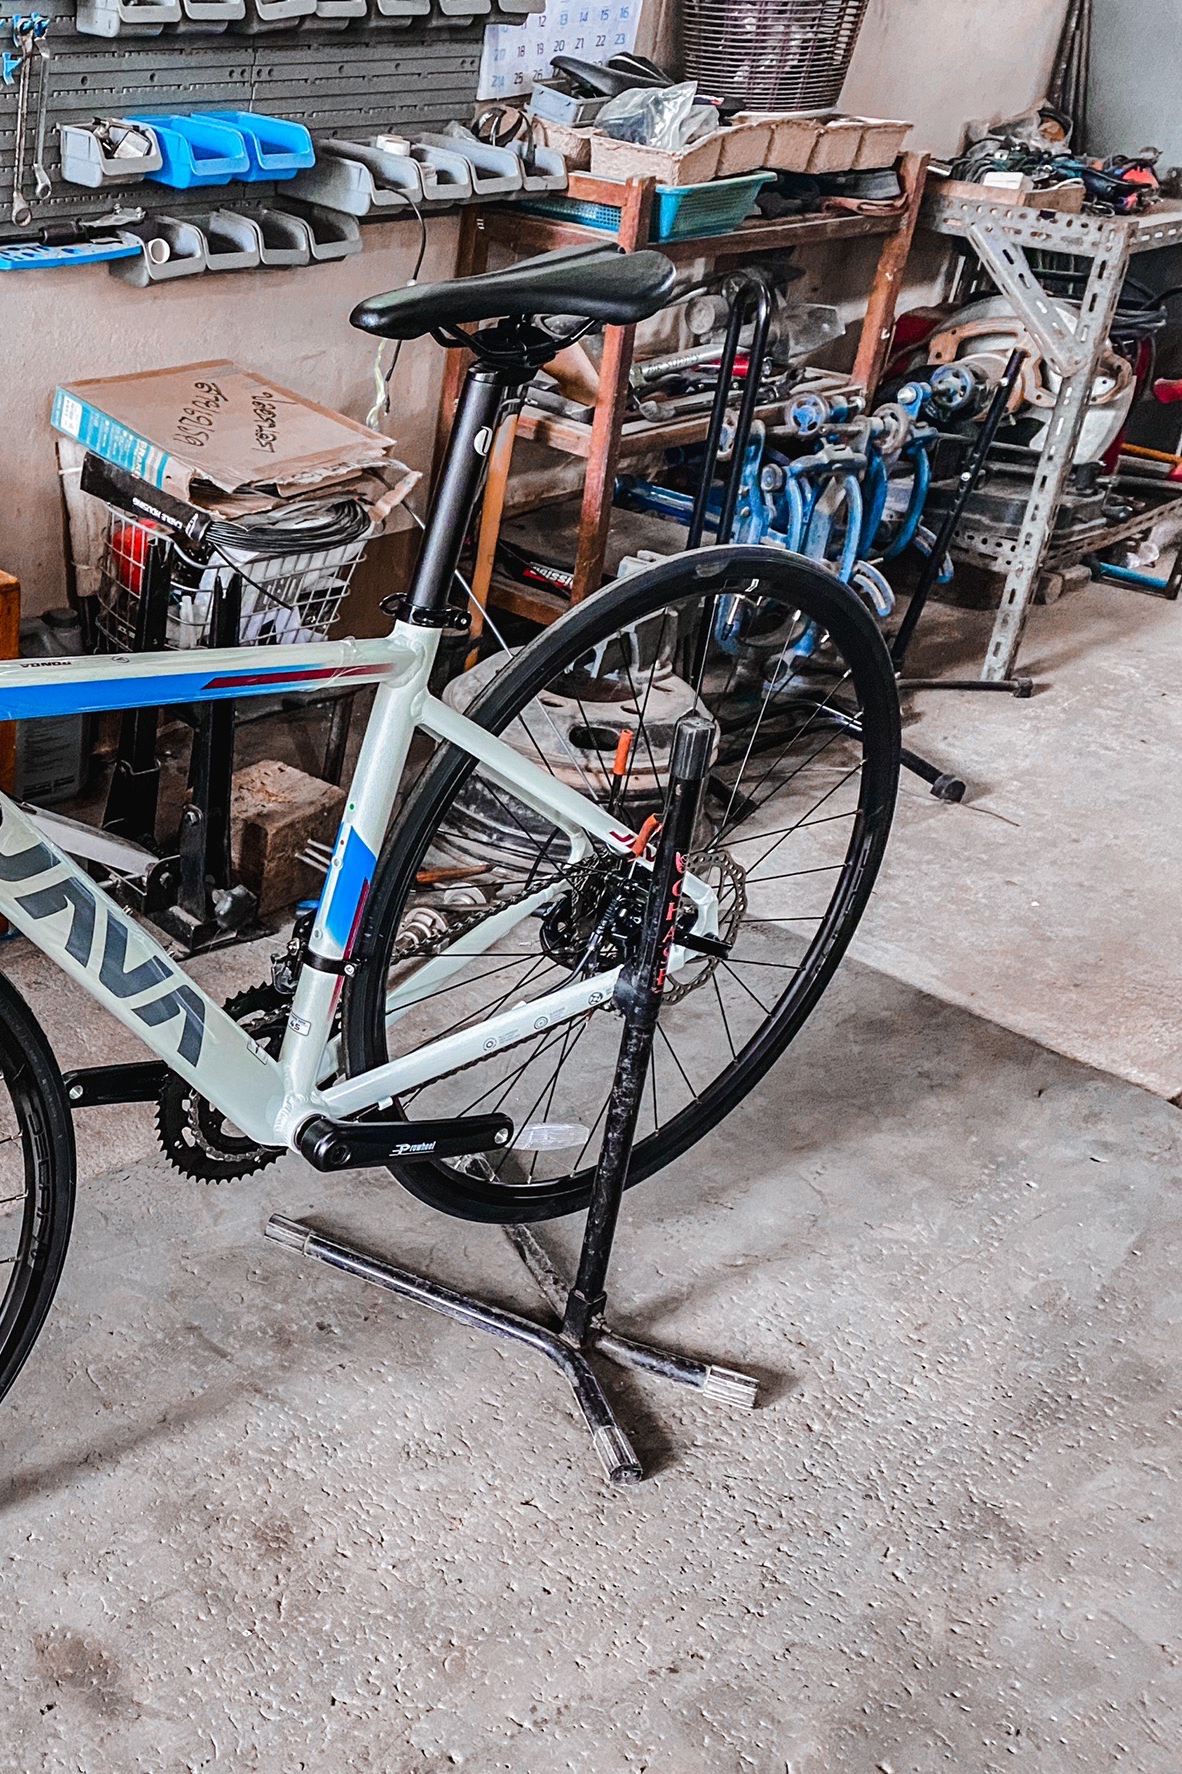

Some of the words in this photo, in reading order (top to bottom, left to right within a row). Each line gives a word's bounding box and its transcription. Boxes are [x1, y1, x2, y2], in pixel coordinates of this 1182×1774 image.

[538, 16, 547, 28] 12
[560, 13, 568, 25] 13
[579, 11, 589, 22] 14
[600, 9, 609, 21] 15
[517, 45, 526, 57] 18
[536, 43, 544, 55] 19
[553, 40, 565, 52] 20
[575, 38, 584, 50] 21
[595, 35, 606, 47] 22
[614, 33, 626, 45] 23
[513, 73, 523, 85] 25
